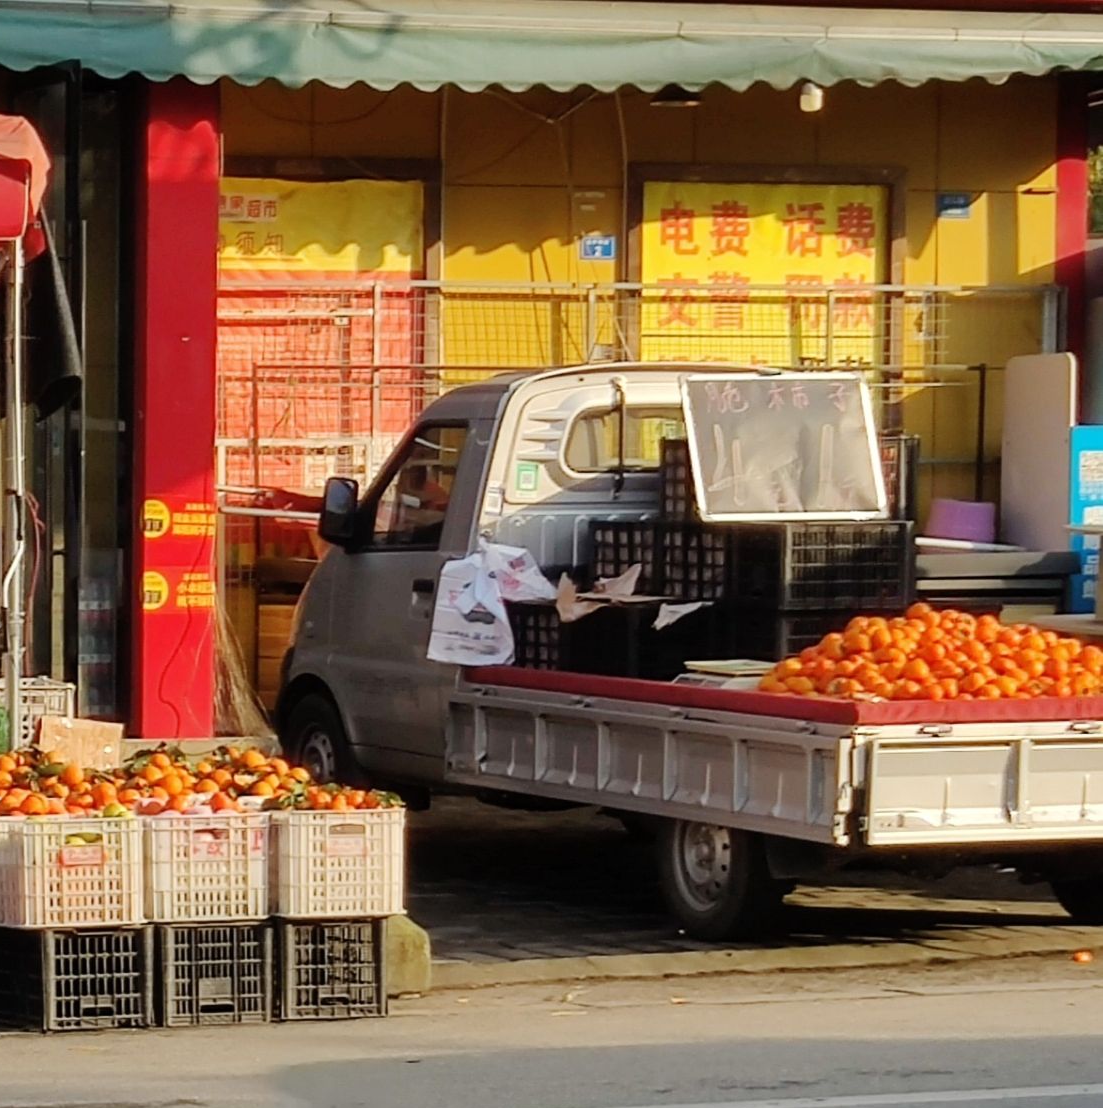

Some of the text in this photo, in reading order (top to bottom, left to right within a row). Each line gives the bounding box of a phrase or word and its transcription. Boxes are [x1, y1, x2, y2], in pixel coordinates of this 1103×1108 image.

[659, 201, 875, 257] 电费 话费
[657, 271, 875, 329] 交警 罚款
